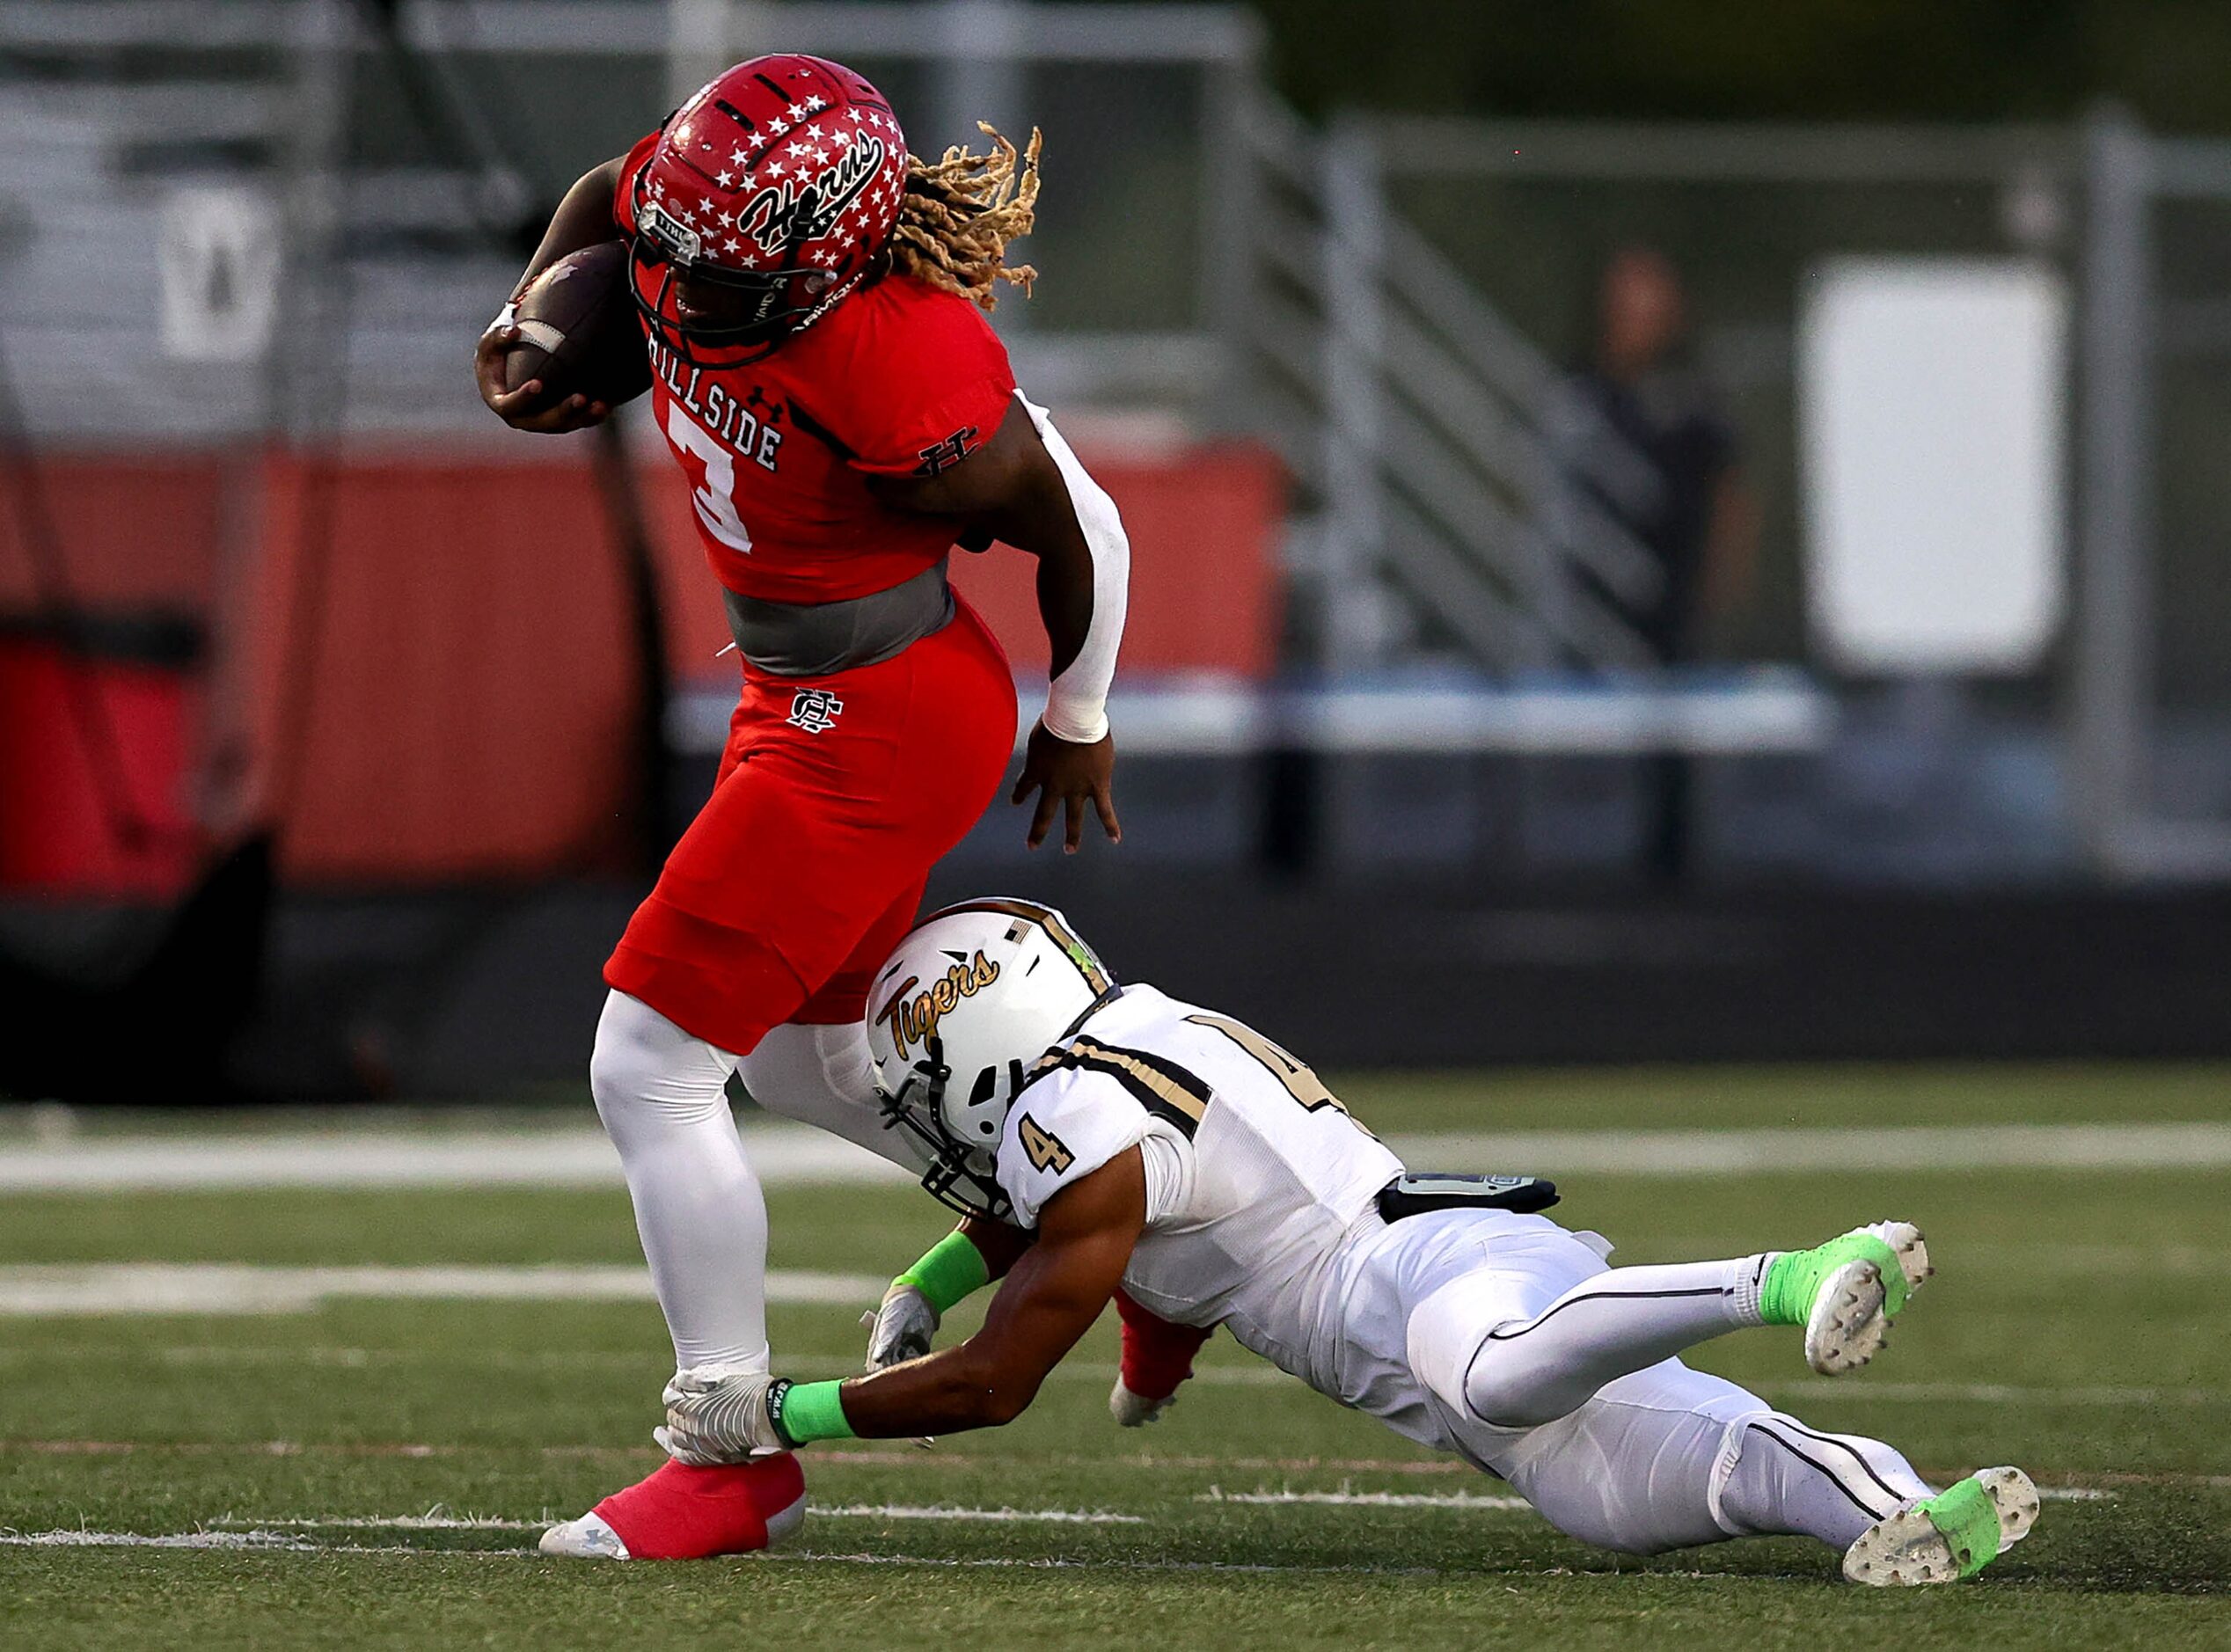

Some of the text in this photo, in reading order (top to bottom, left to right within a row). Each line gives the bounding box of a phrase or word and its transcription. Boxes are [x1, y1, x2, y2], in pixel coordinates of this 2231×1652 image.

[753, 276, 788, 323] NDR
[647, 331, 782, 471] HILLSIDE
[668, 398, 753, 555] 3
[875, 949, 1000, 1062] Tigers
[1018, 1110, 1076, 1177] 4
